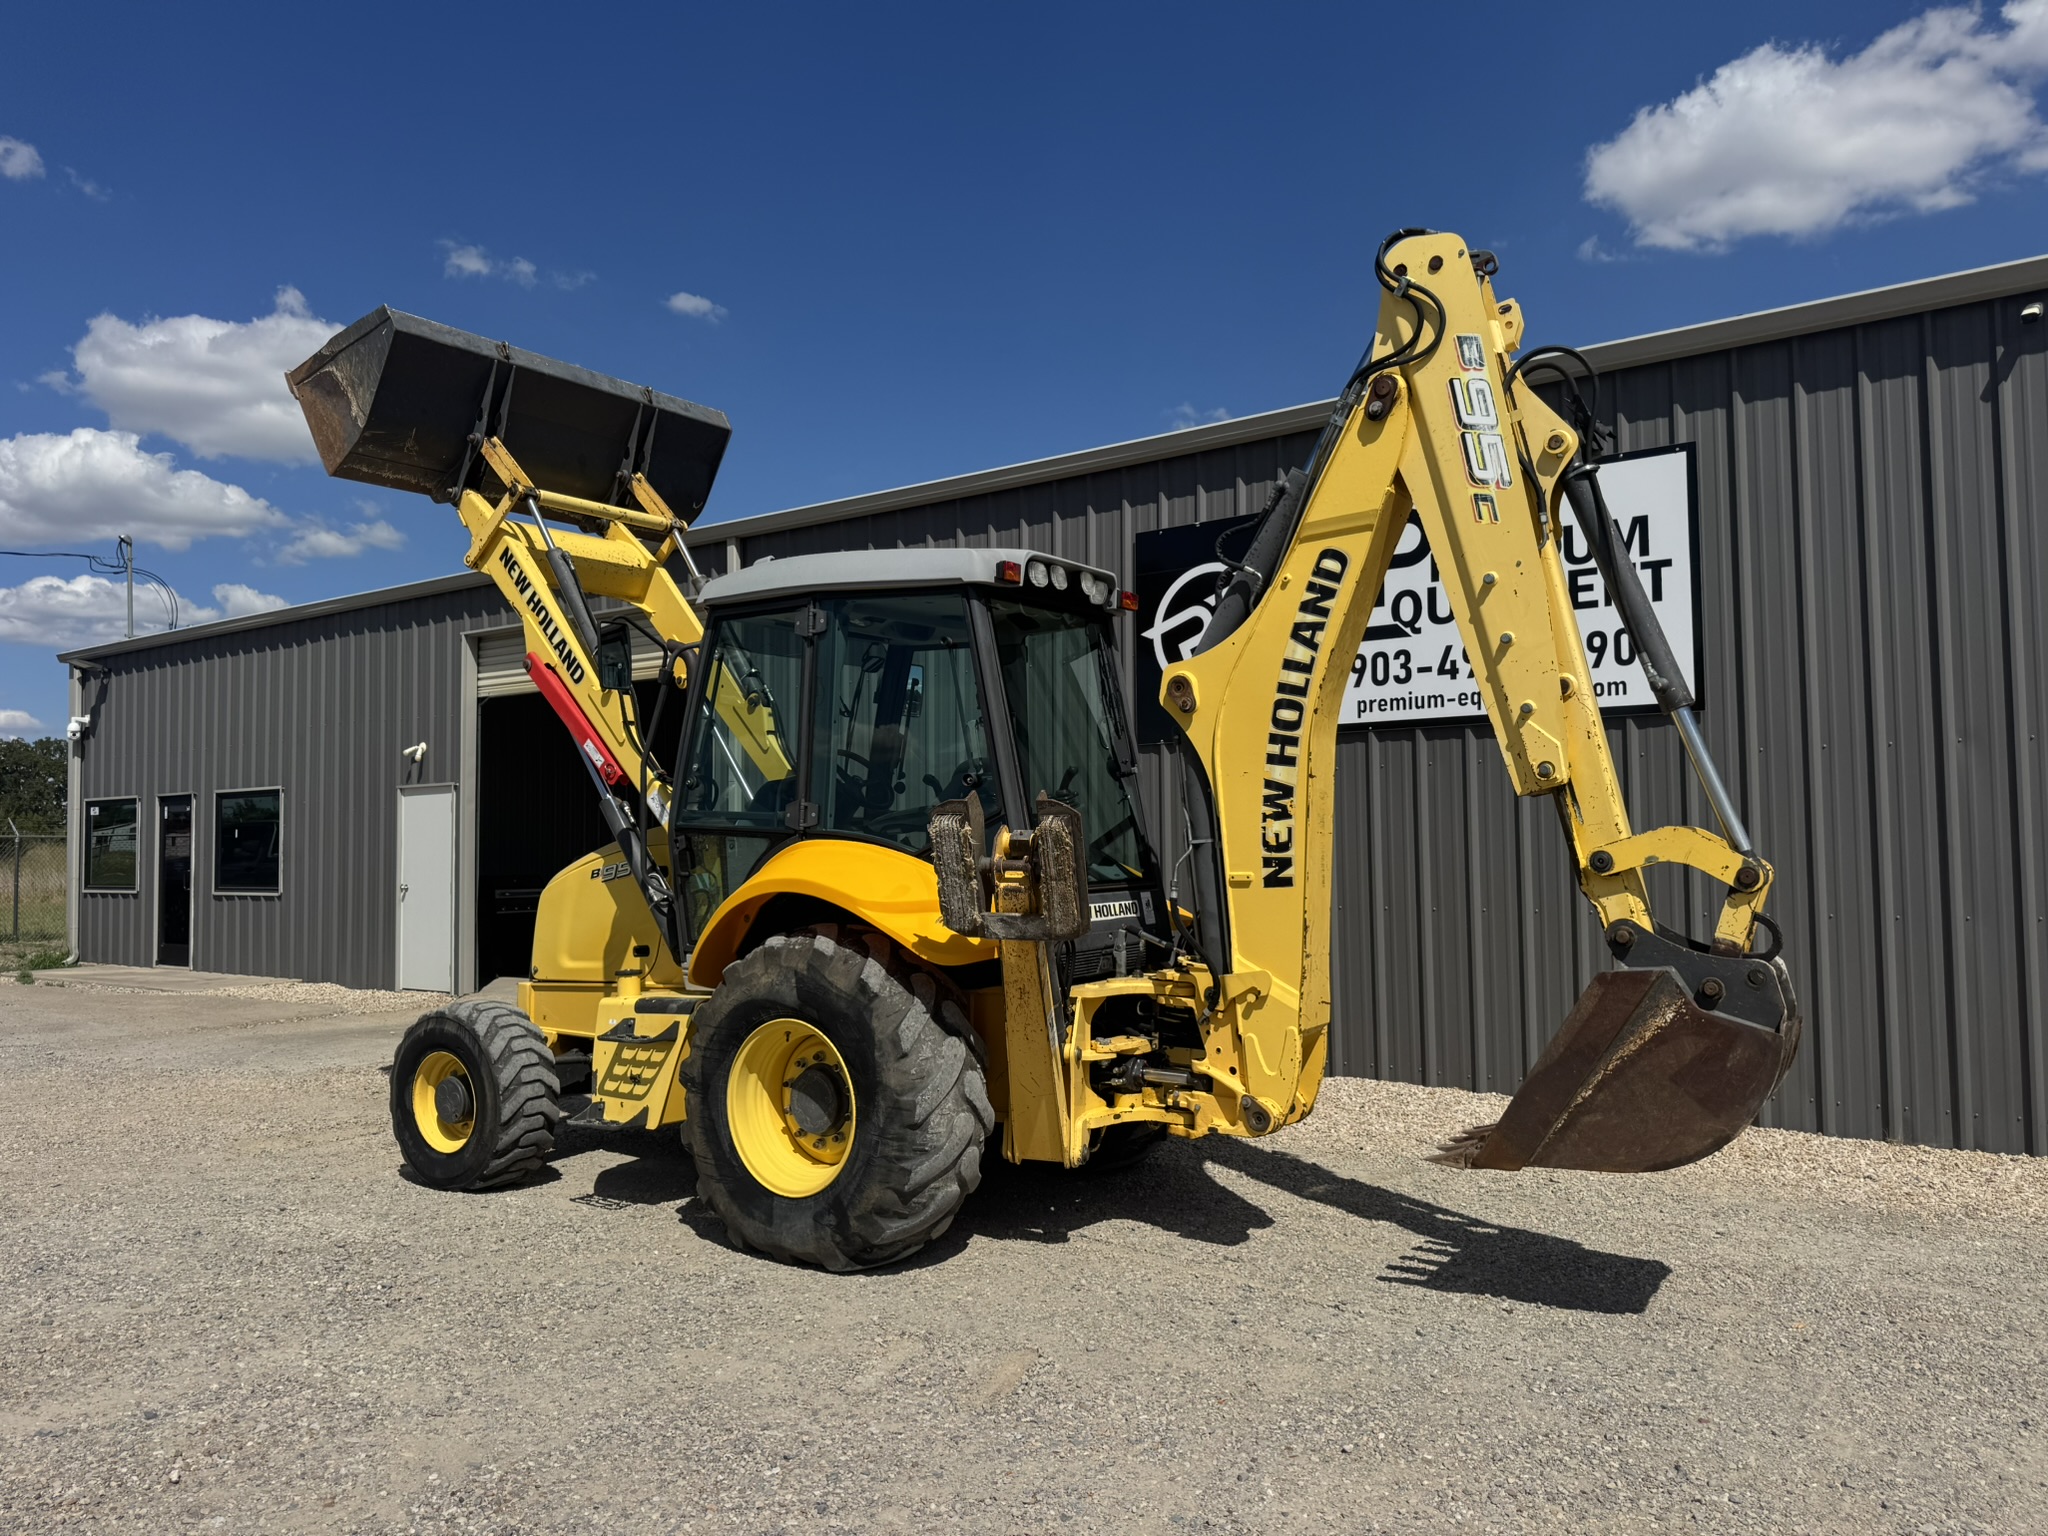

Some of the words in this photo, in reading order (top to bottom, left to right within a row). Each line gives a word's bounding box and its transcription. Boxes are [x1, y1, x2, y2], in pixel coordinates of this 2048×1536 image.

[499, 546, 532, 596] NEW
[526, 589, 585, 685] HOLLAND
[1265, 547, 1350, 768] HOLLAND
[1261, 777, 1295, 889] NEW
[1094, 901, 1138, 918] HOLLAND
